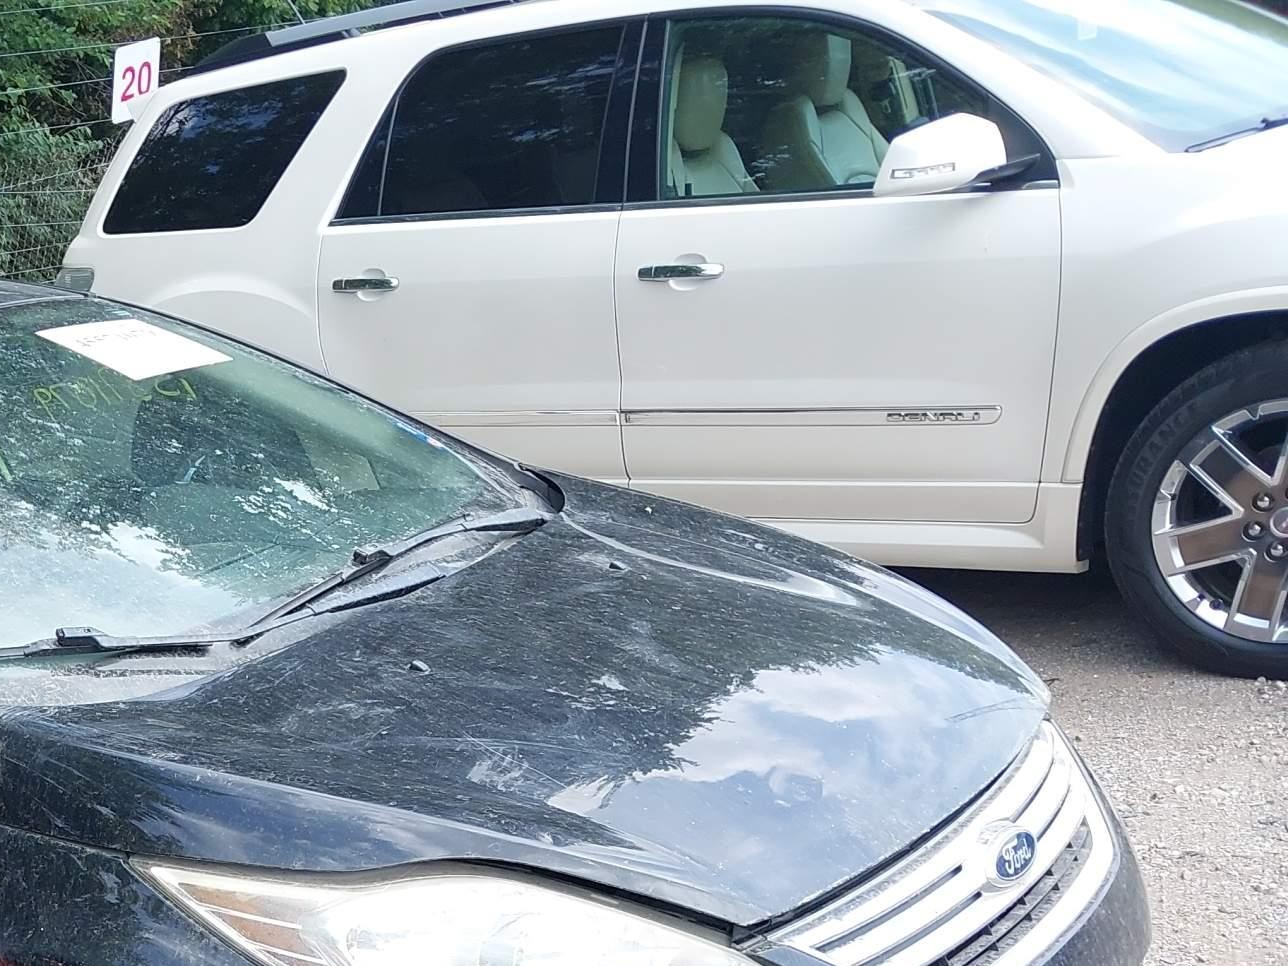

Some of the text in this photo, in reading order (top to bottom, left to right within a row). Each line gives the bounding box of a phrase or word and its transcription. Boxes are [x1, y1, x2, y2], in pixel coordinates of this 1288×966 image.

[121, 61, 152, 102] 20
[886, 411, 981, 422] DENALI
[1002, 837, 1032, 875] Ford
